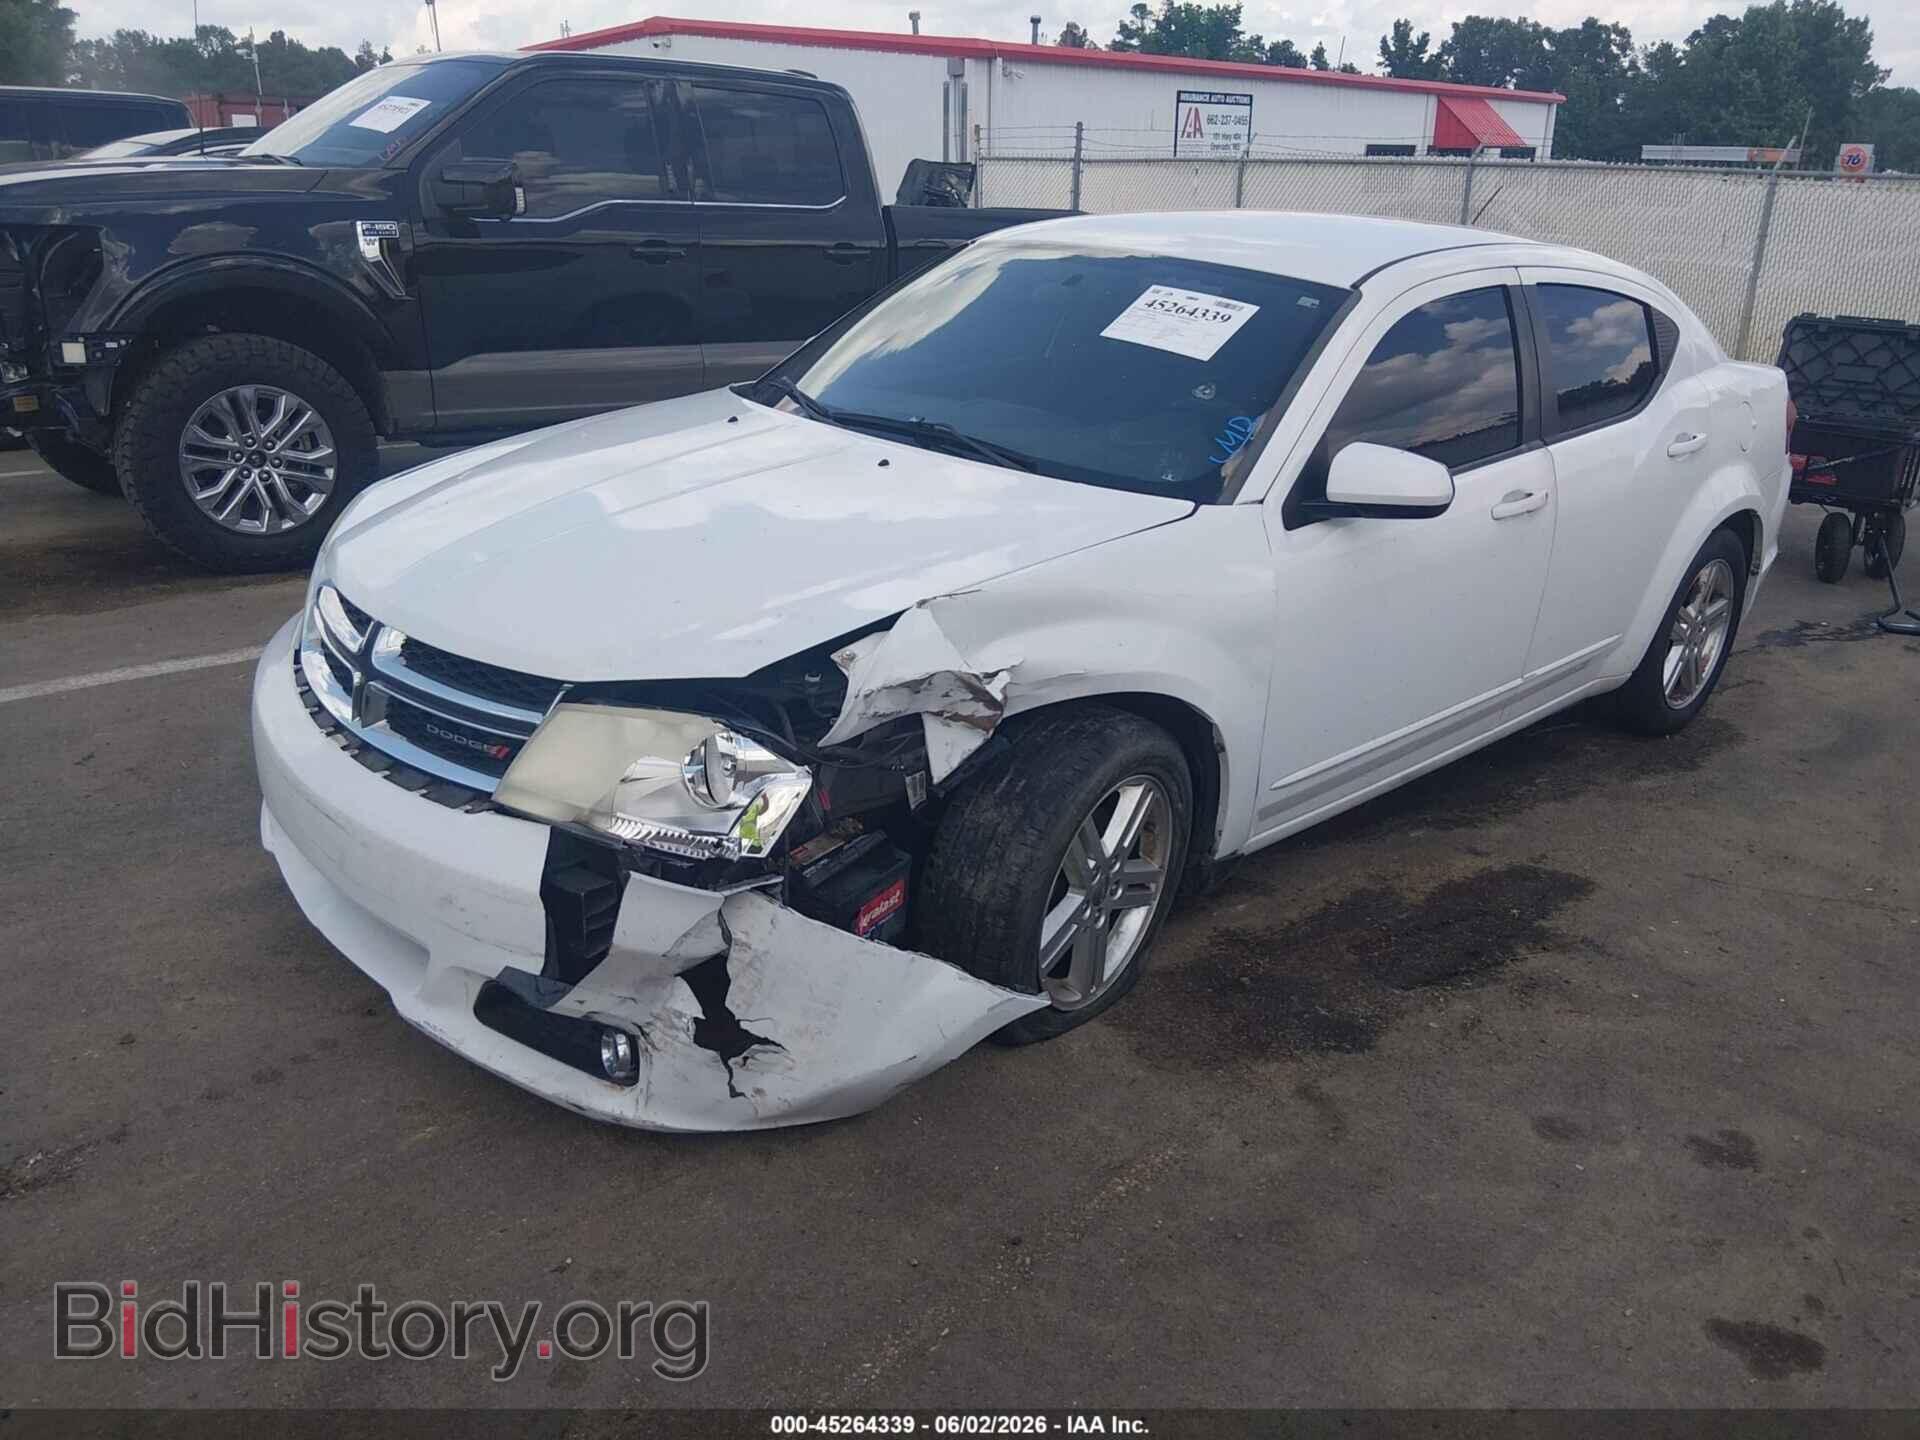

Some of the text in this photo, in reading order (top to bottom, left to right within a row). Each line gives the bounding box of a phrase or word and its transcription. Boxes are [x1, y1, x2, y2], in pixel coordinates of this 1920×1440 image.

[1846, 153, 1861, 165] 76
[1144, 298, 1232, 323] 45264339
[425, 723, 499, 754] DODGE
